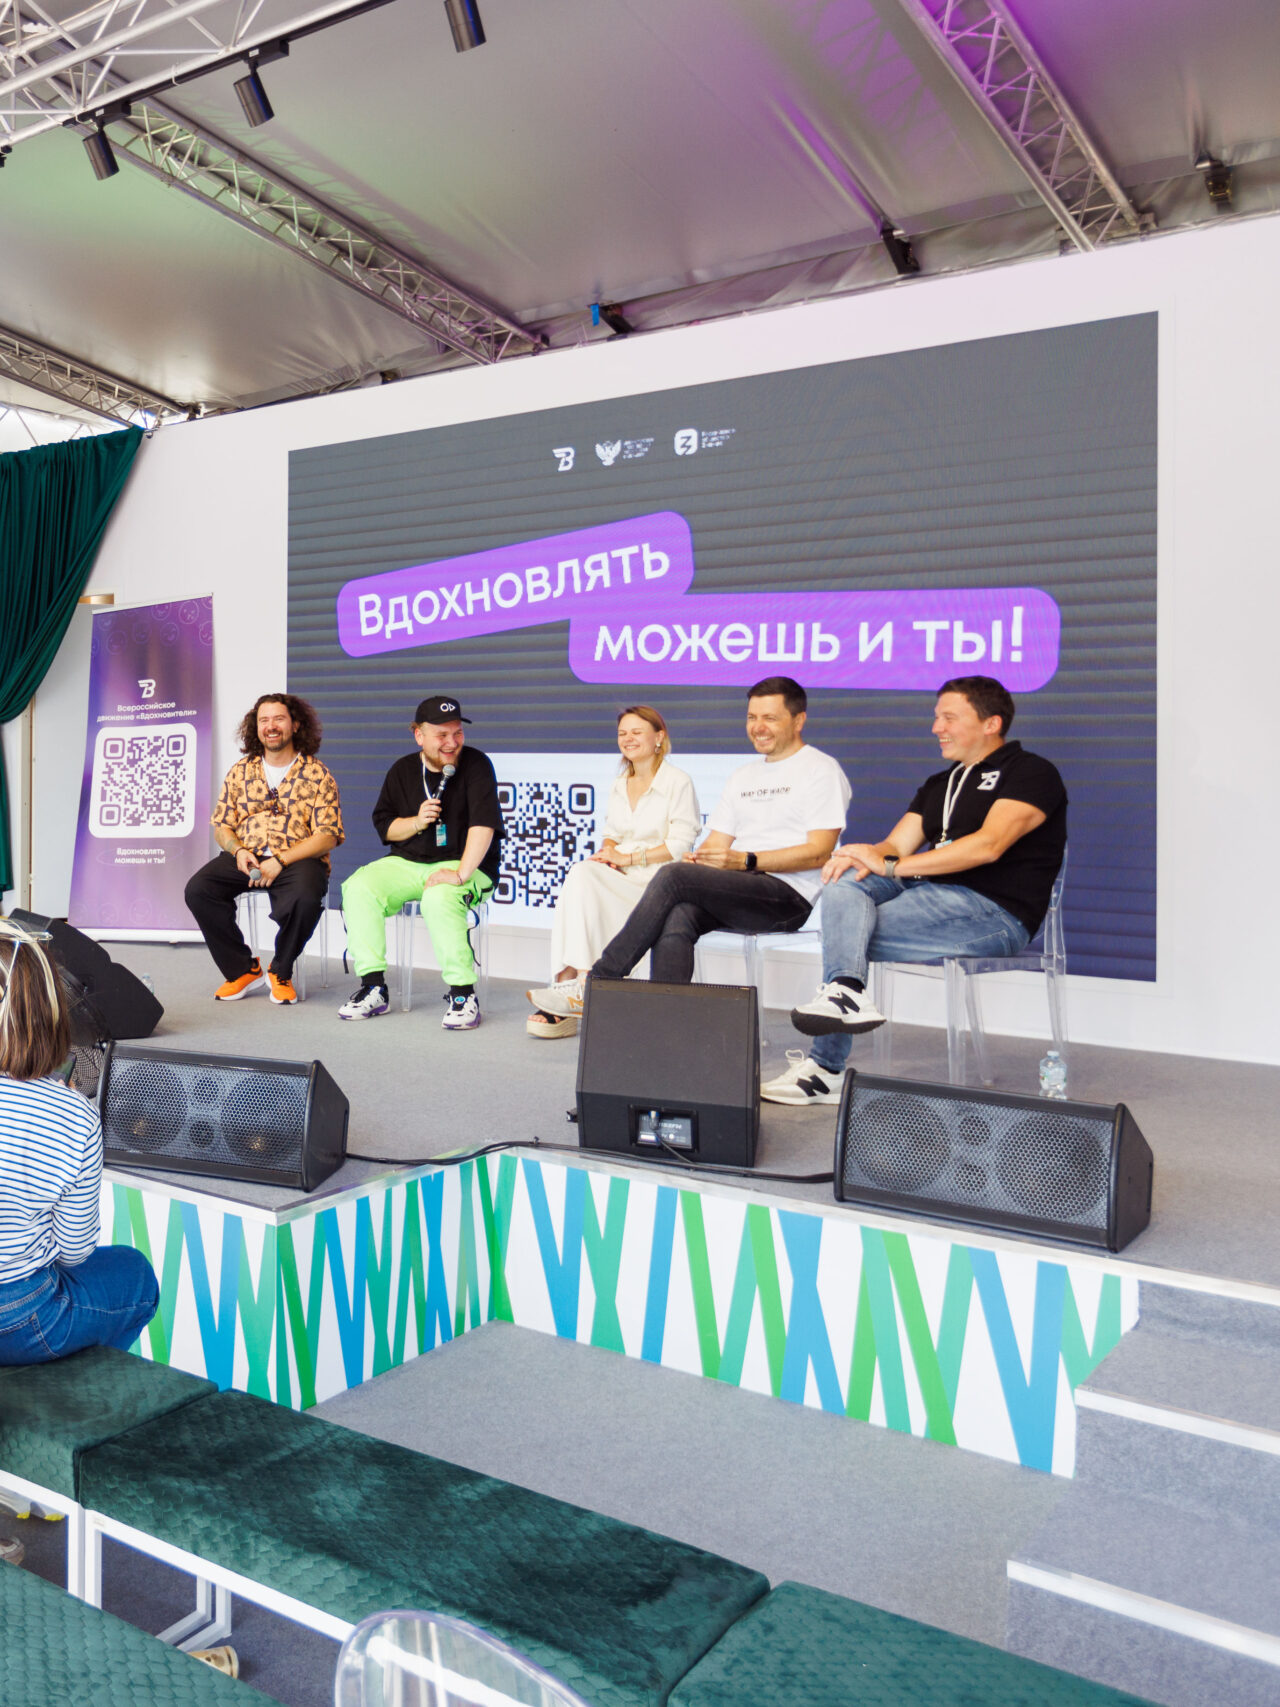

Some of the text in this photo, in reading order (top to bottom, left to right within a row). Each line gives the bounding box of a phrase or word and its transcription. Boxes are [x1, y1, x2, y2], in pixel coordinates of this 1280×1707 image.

[358, 542, 670, 639] Вдохновлять
[593, 605, 1024, 663] можешь и ты!
[117, 701, 176, 713] Всероссийское
[97, 714, 135, 722] движение
[116, 848, 165, 856] Вдохновлять
